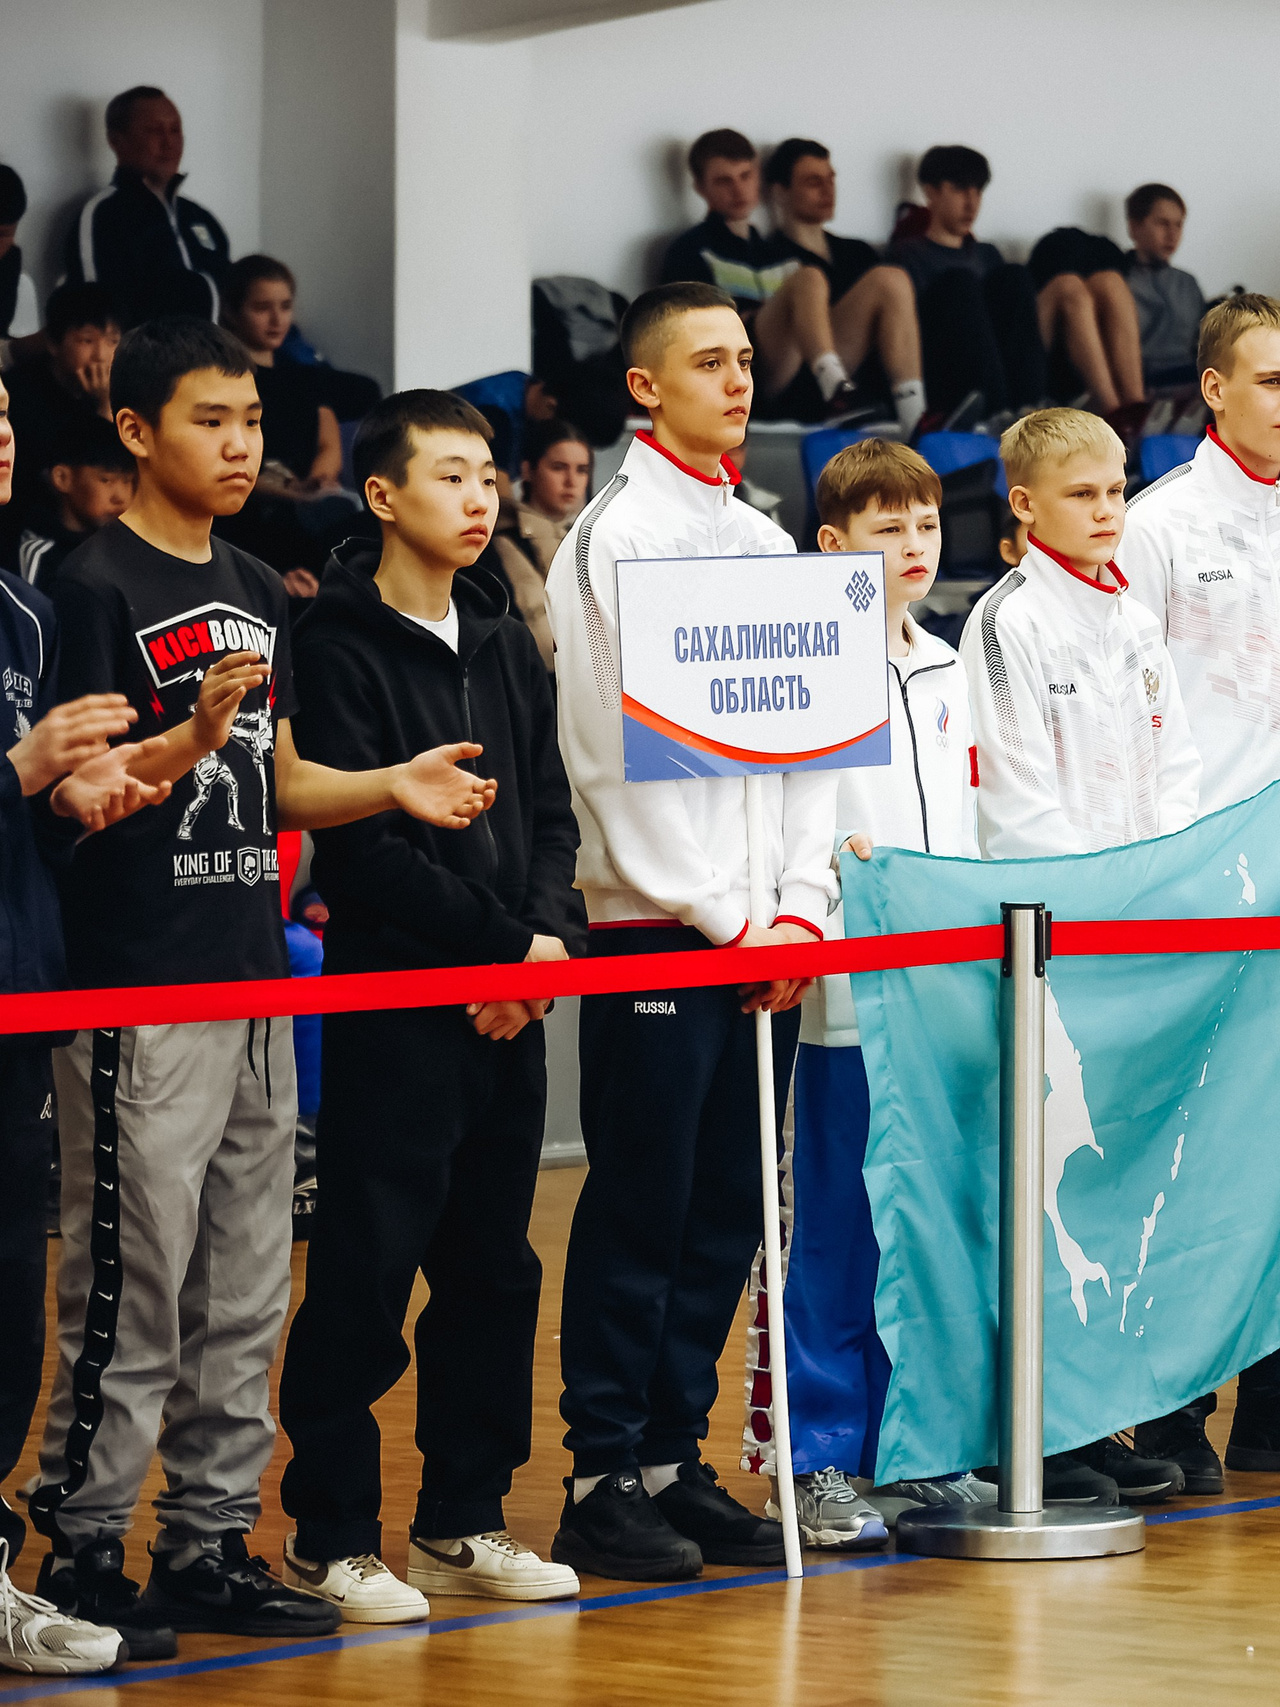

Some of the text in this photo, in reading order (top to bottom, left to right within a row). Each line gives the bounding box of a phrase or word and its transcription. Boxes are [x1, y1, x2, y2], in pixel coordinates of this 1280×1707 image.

[1198, 568, 1234, 583] RUSSIA
[148, 619, 270, 671] KICKBOXIN
[674, 621, 840, 663] САХАЛИНСКАЯ
[710, 675, 811, 714] ОБЛАСТЬ
[173, 852, 209, 877] KING
[214, 850, 232, 873] OF
[634, 1001, 677, 1016] RUSSIA
